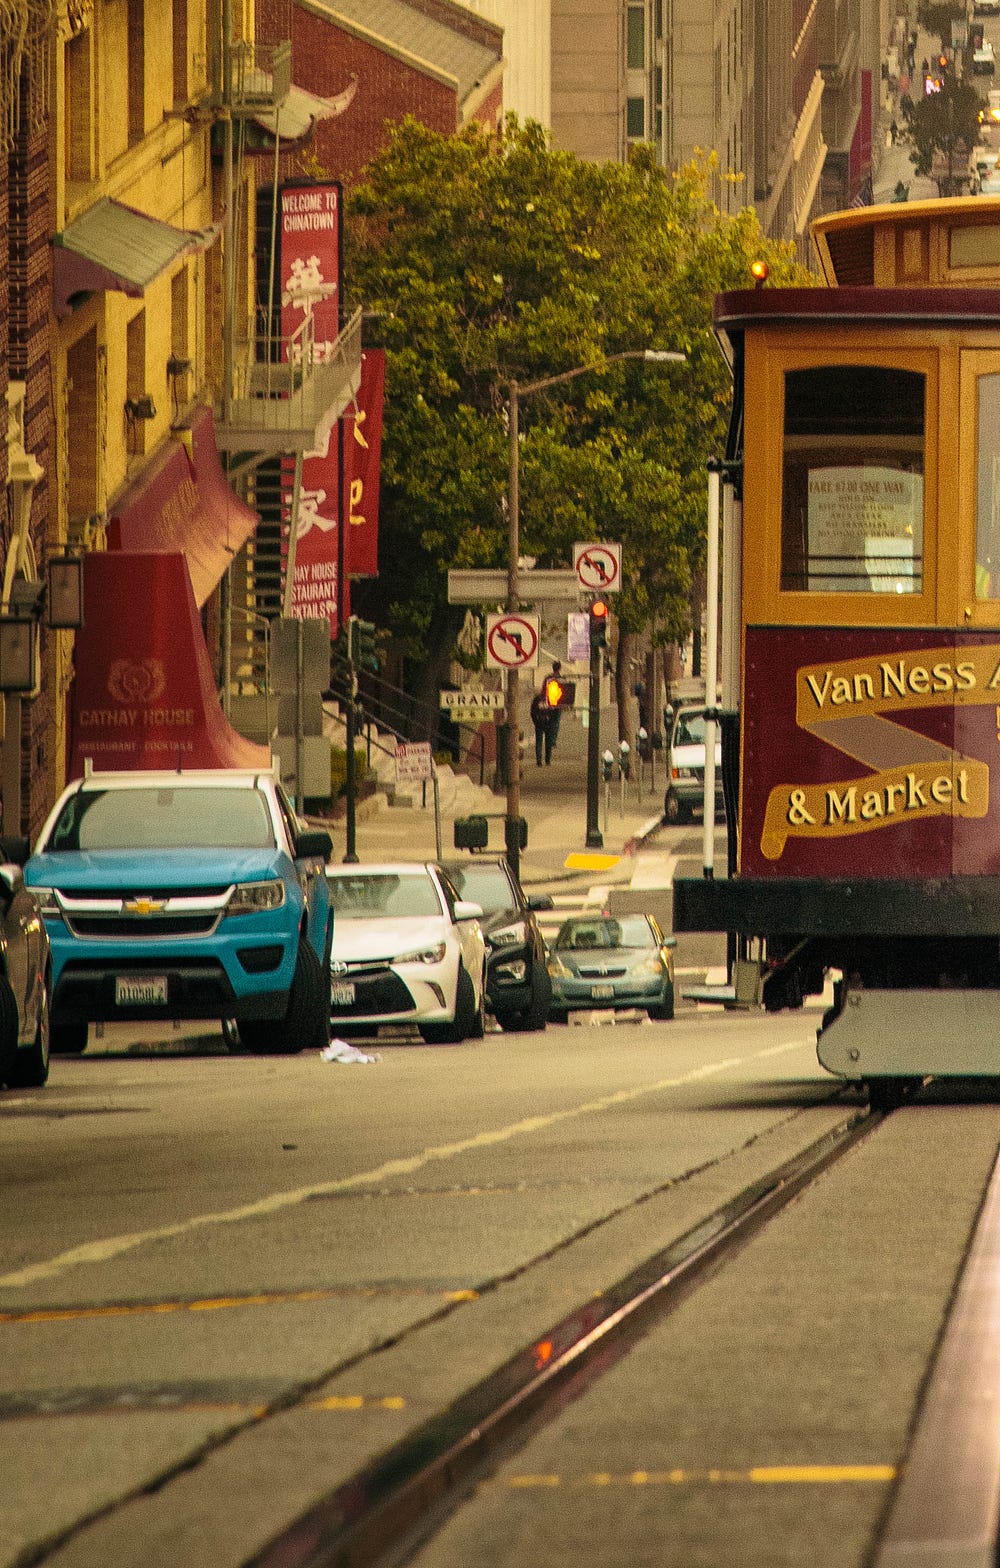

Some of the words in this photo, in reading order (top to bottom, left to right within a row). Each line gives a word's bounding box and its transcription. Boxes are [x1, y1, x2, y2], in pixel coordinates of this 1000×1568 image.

[281, 193, 322, 212] WELCOME
[326, 192, 337, 210] TO
[283, 212, 334, 232] CHINATOWN
[311, 561, 337, 581] HOUSE
[807, 671, 875, 708] Van
[879, 660, 977, 699] Ness
[446, 692, 499, 706] GRANT
[79, 709, 137, 727] CATHAY
[143, 709, 194, 727] HOUSE
[788, 789, 815, 825] &
[824, 769, 969, 826] Market
